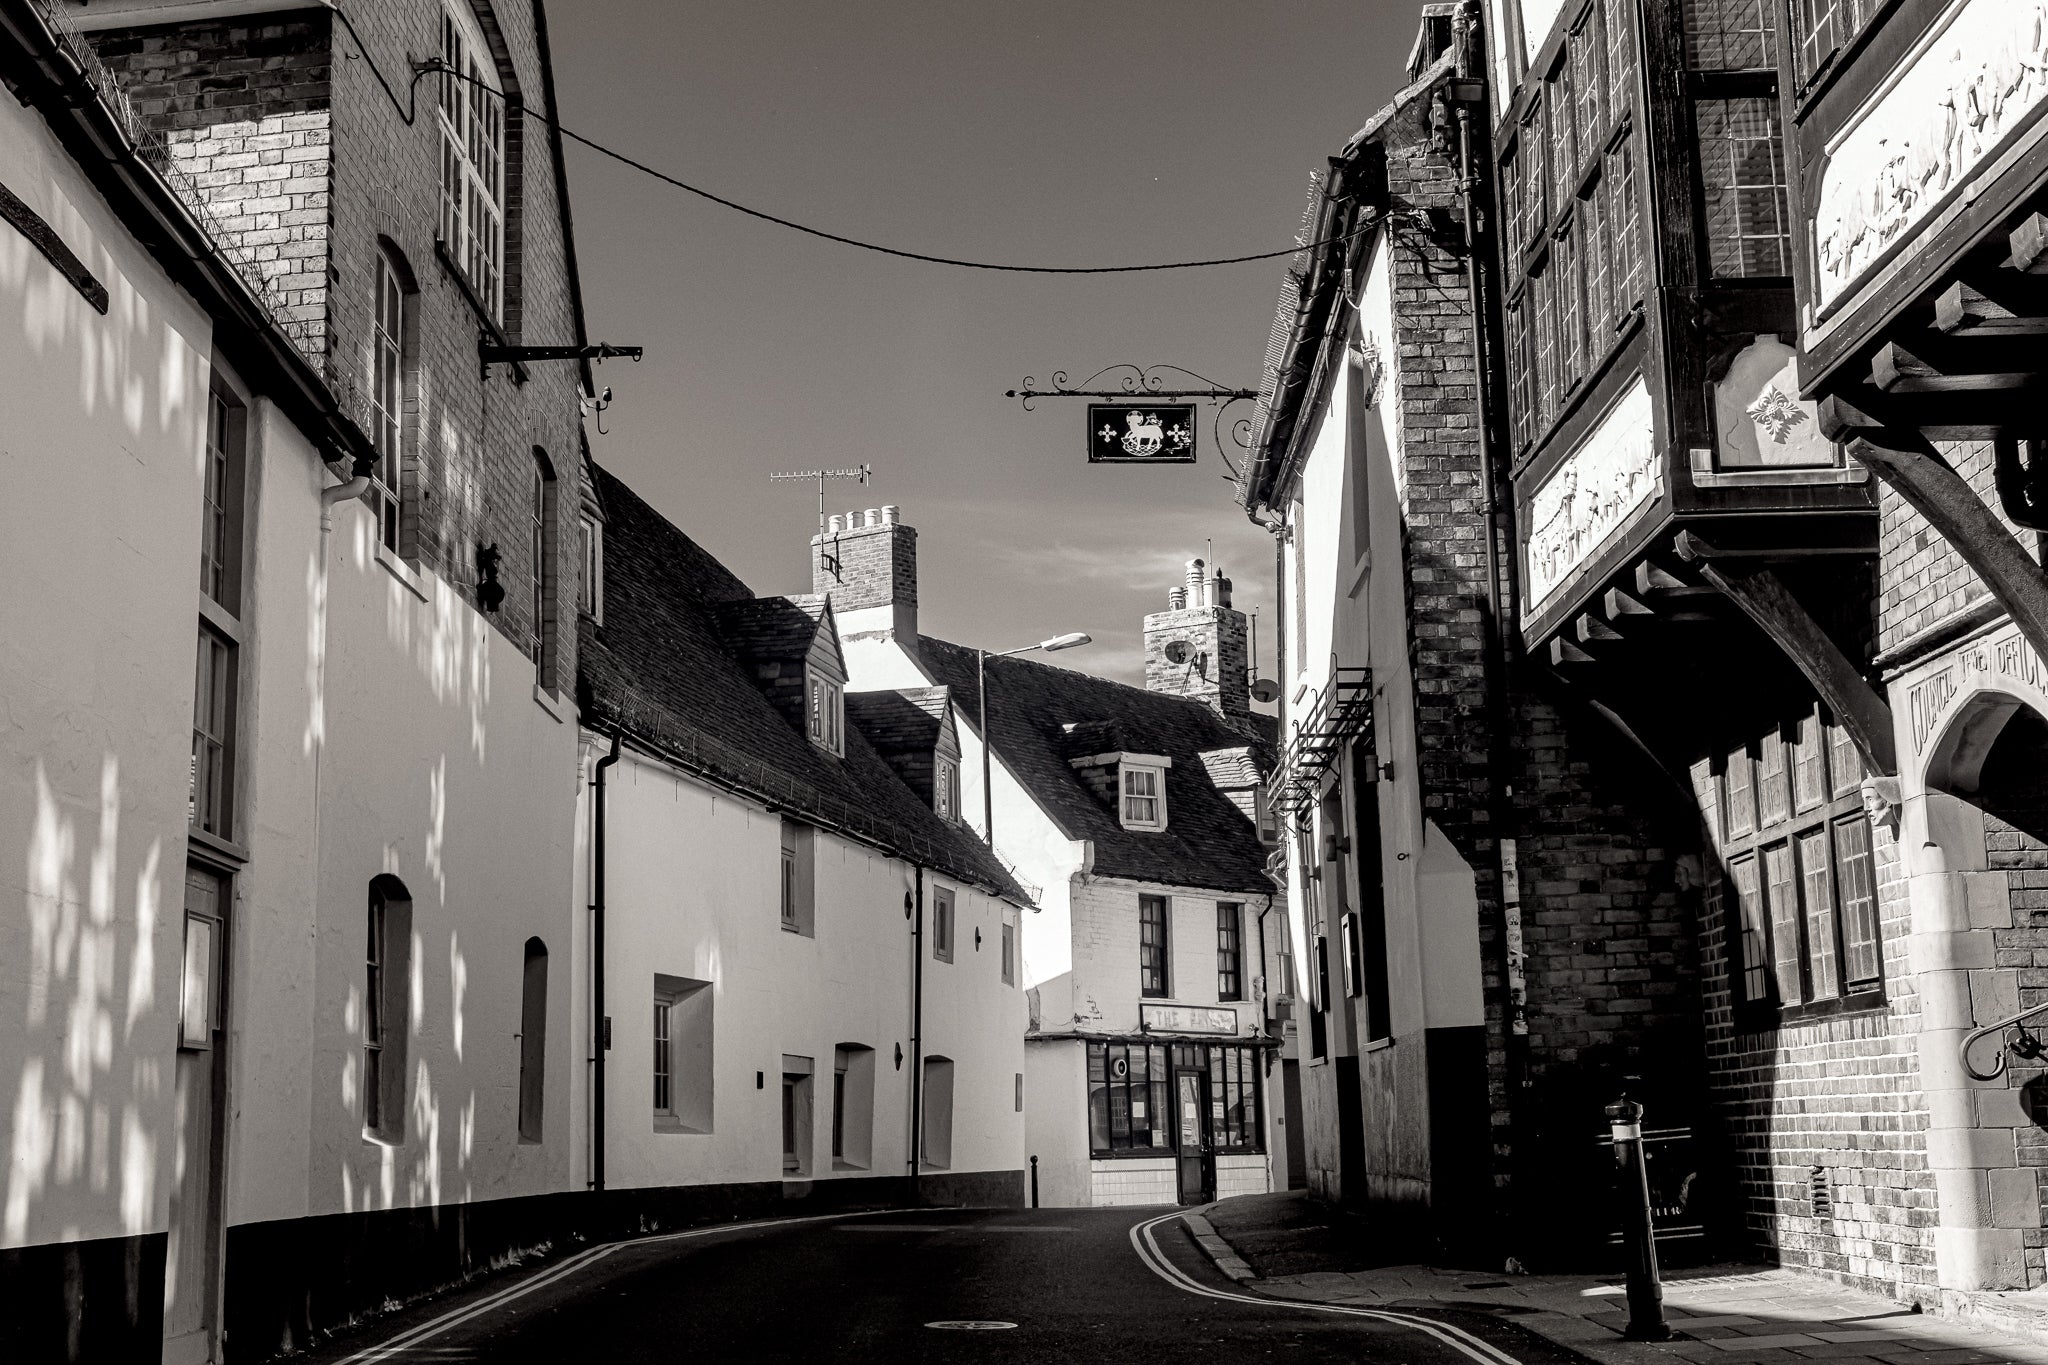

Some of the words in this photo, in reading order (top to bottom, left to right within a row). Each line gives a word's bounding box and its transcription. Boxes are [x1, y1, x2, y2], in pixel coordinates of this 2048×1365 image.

[1910, 671, 1958, 757] COUNCIL
[1997, 636, 2048, 699] OFFIC
[1156, 1010, 1180, 1028] THE
